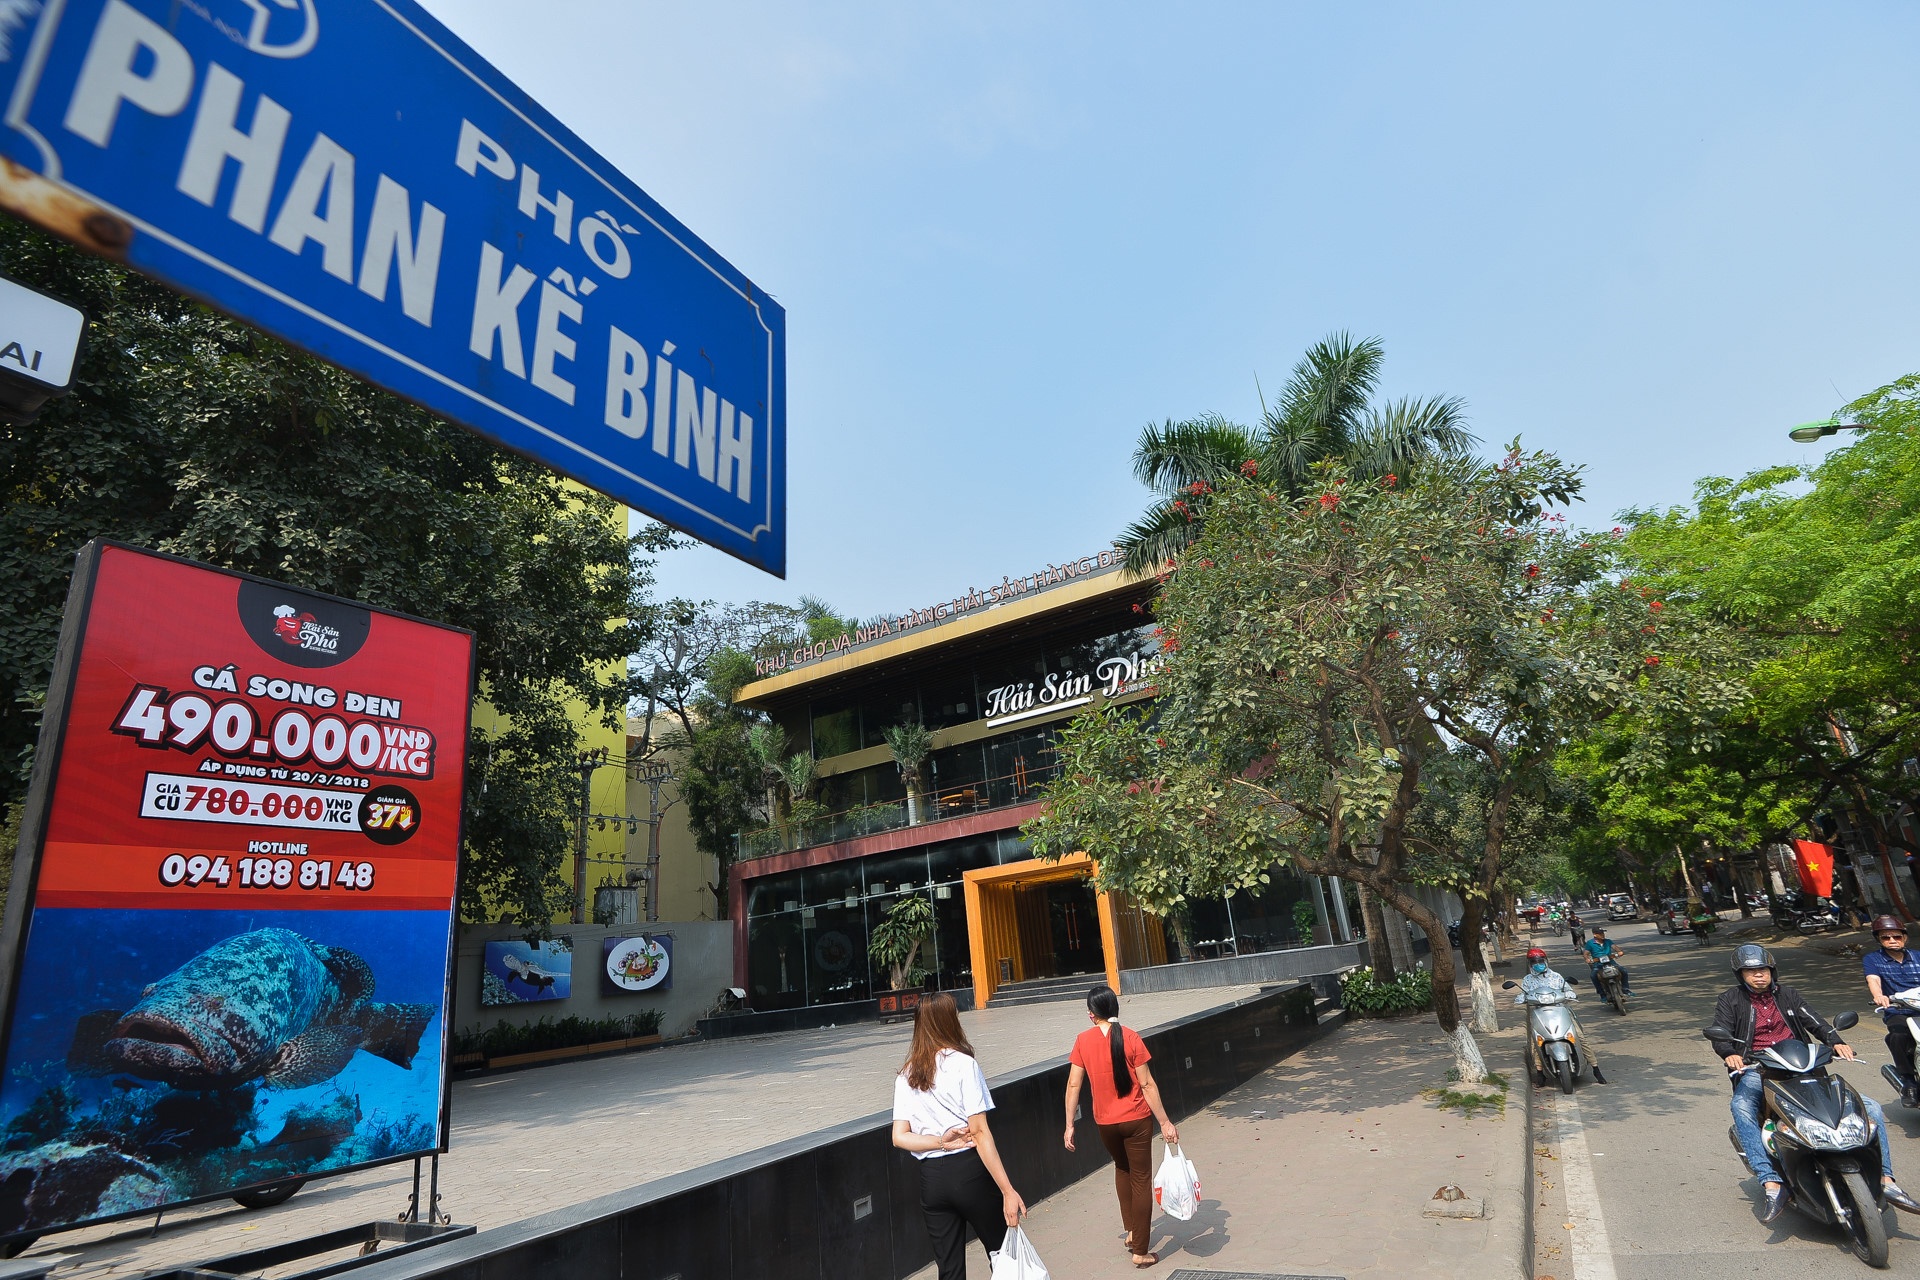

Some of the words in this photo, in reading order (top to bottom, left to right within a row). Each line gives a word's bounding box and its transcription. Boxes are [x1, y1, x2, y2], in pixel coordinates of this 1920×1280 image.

[455, 118, 641, 280] PHỐ
[63, 0, 447, 328] PHAN
[469, 242, 598, 406] KẾ
[604, 325, 753, 504] BÍNH
[755, 655, 787, 677] KHU
[793, 640, 828, 662] CHỢ
[831, 631, 852, 652] VÀ
[855, 618, 892, 645] NHÀ
[897, 603, 947, 632] HÀNG
[953, 587, 985, 614] HẢI
[990, 576, 1028, 603] SẢN
[1032, 557, 1091, 589] HÀNG
[194, 665, 237, 692] CÁ
[247, 676, 336, 708] SONG
[345, 692, 401, 719] ĐEN
[985, 682, 1035, 717] Hải
[1039, 670, 1093, 703] Sản
[119, 689, 381, 767] 490.000
[383, 726, 430, 751] VNĐ
[200, 759, 221, 772] ÁP
[225, 764, 267, 777] DỤNG
[270, 768, 289, 779] TỪ
[291, 771, 370, 788] 20/3/2018
[184, 785, 323, 821] 780.000
[325, 798, 352, 811] VNĐ
[161, 854, 231, 885] 094
[239, 858, 292, 887] 188
[300, 859, 332, 887] 81
[337, 862, 374, 888] 48
[249, 841, 308, 856] HOTLINE
